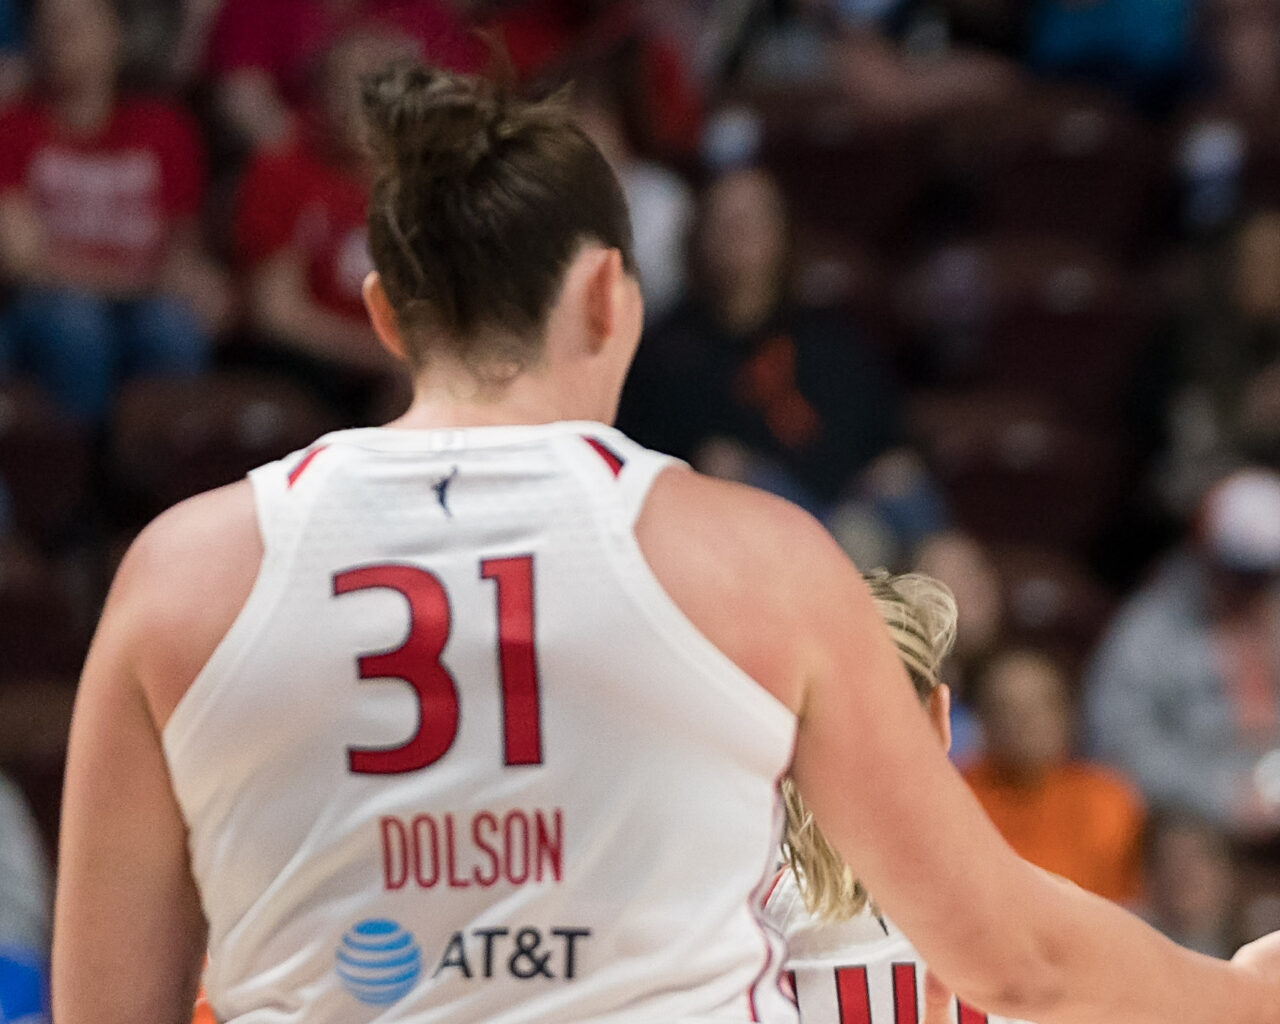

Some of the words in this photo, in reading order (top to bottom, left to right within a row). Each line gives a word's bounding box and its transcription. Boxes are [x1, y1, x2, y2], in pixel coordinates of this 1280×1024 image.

[331, 553, 543, 774] 31
[380, 807, 563, 890] DOLSON
[433, 926, 592, 980] AT&T
